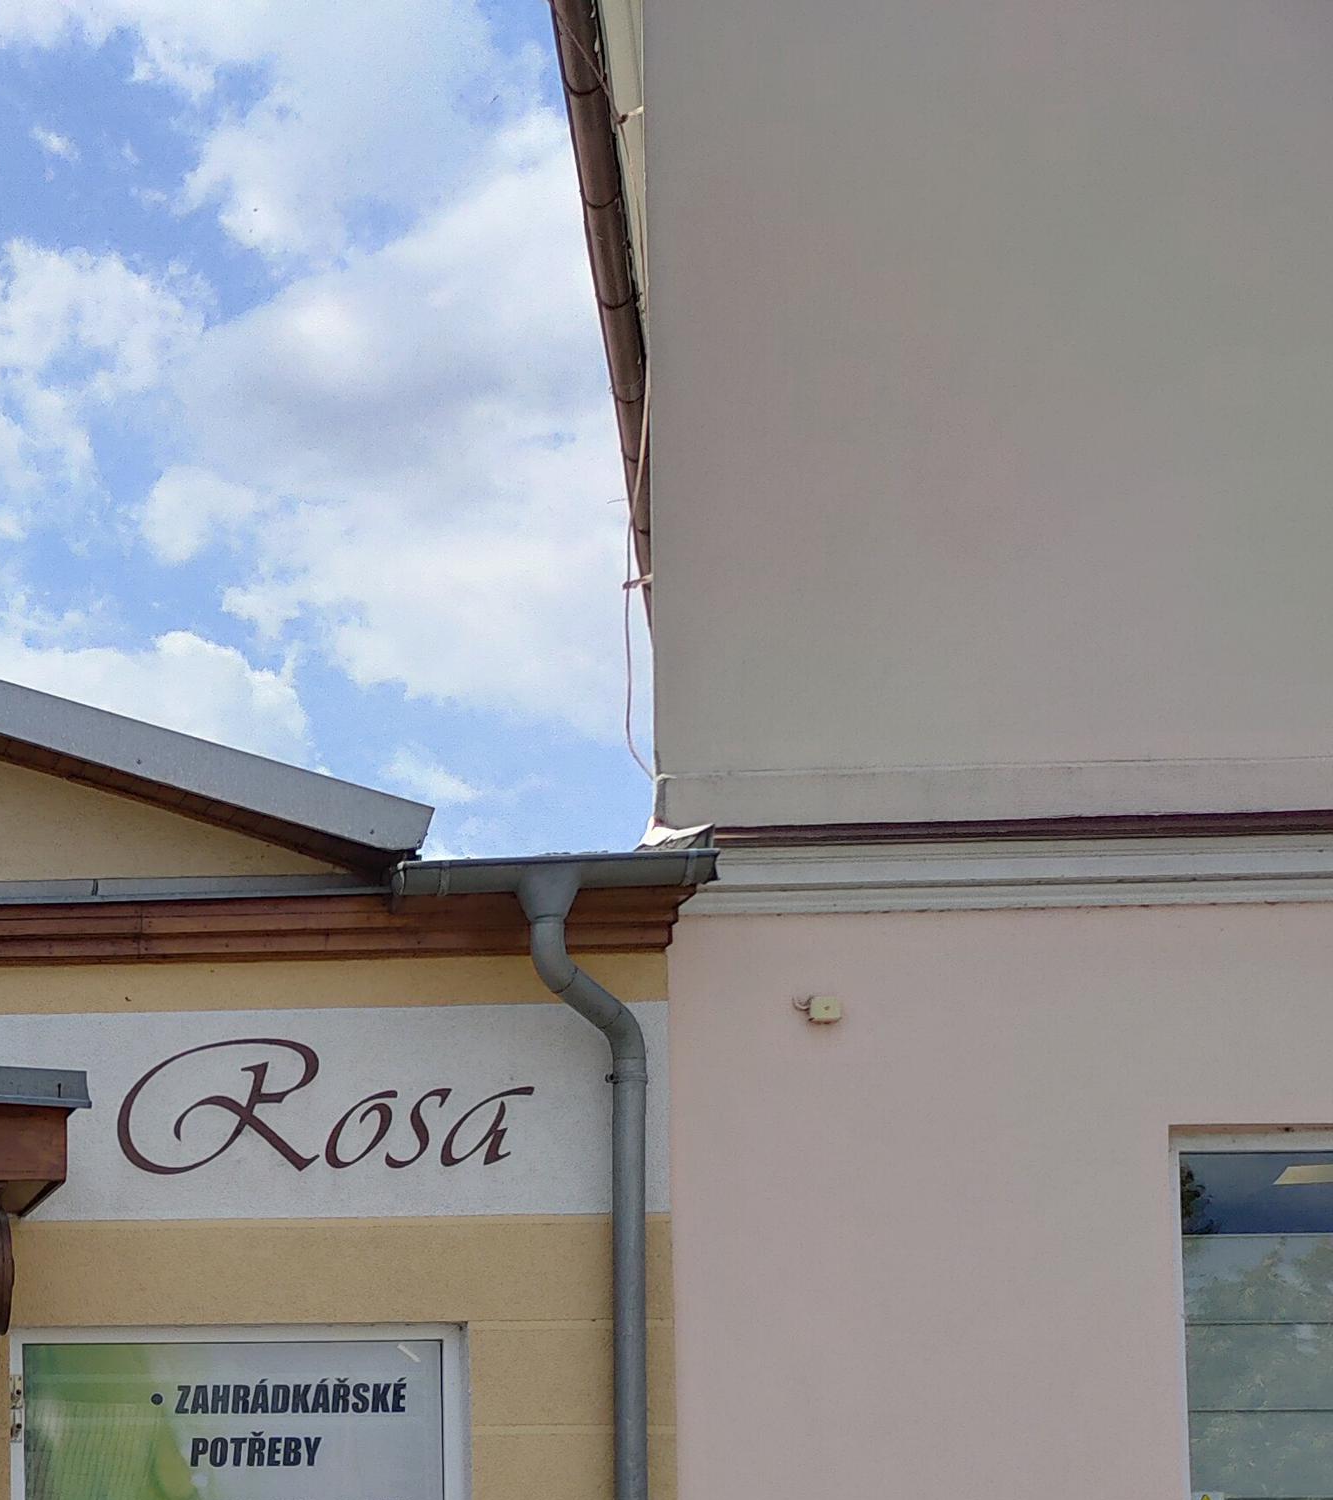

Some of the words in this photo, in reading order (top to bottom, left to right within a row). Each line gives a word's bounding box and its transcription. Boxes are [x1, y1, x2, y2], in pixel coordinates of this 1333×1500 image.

[117, 1038, 535, 1175] Rosa
[174, 1377, 407, 1414] ZAHRÁDKÁŘSKÉ
[190, 1432, 322, 1467] POTŘEBY
